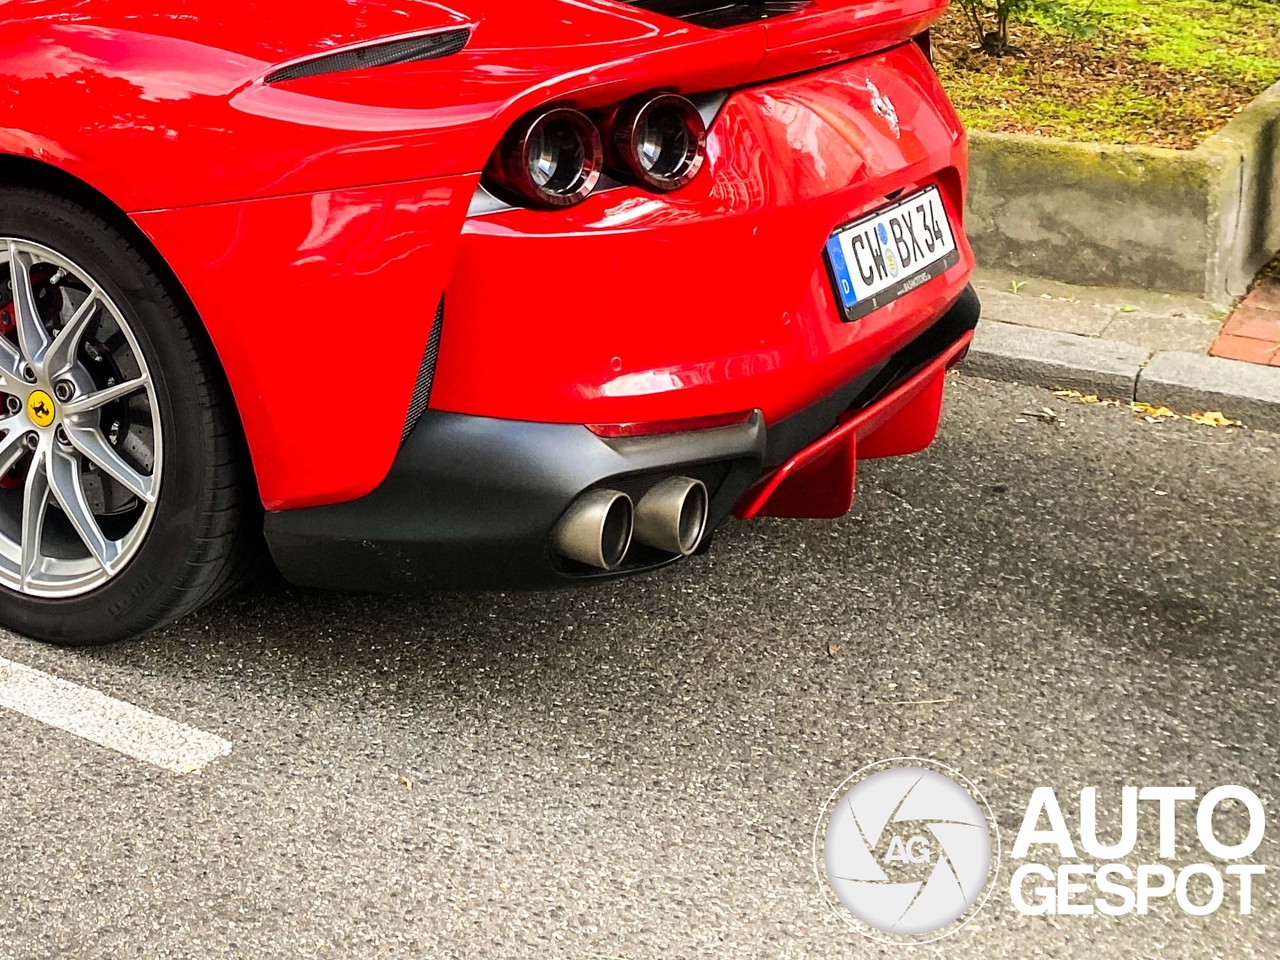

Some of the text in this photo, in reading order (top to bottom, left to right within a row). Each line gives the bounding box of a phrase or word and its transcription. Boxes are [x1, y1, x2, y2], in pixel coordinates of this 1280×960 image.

[841, 200, 945, 294] D CW BX 34
